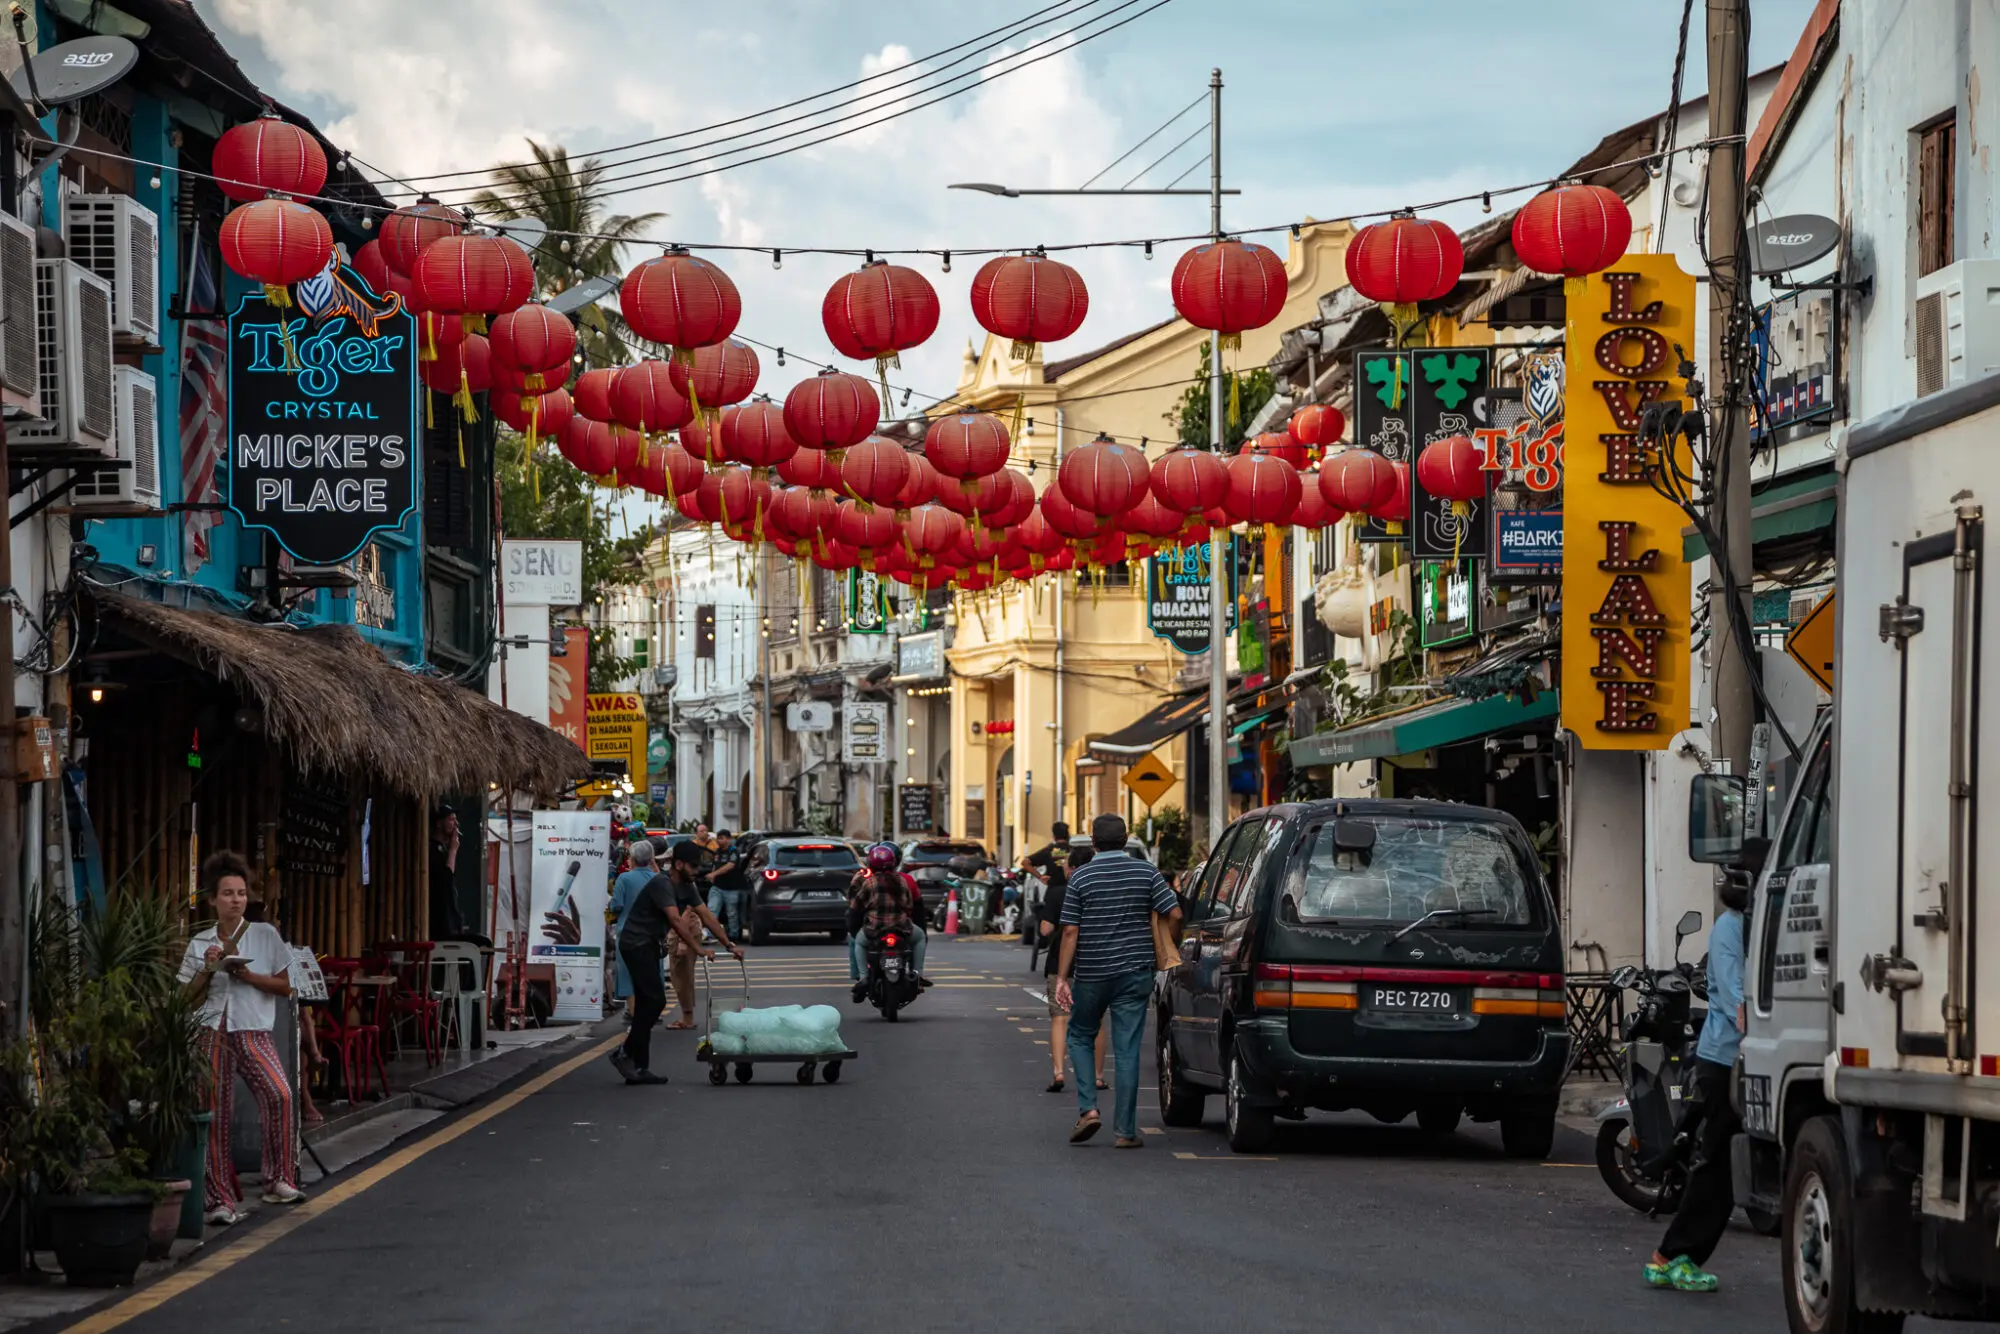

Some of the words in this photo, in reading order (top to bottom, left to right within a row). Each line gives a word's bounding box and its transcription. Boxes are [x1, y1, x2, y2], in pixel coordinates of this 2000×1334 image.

[62, 52, 114, 67] astro
[1766, 232, 1813, 245] astro
[239, 317, 404, 397] Tiger
[1593, 272, 1668, 484] LOVE
[265, 401, 379, 419] CRYSTAL
[238, 434, 406, 469] MICKE'S
[1473, 422, 1565, 492] Tig
[256, 478, 388, 512] PLACE
[1176, 586, 1210, 601] HOLY
[1152, 601, 1234, 618] GUACAME
[1152, 620, 1184, 628] MEXICAN
[1588, 521, 1666, 733] LANE
[1176, 629, 1192, 637] AND
[1193, 629, 1209, 637] BAR
[586, 696, 638, 711] AWAS
[612, 712, 645, 723] SEKOLAH
[550, 722, 577, 738] nk
[589, 726, 597, 735] DI
[599, 725, 632, 734] HADAPAN
[595, 742, 628, 751] SEKOLAH
[285, 832, 337, 853] WINE
[538, 848, 557, 856] Tune
[558, 848, 564, 856] It
[565, 848, 585, 856] Your
[586, 848, 604, 858] Way
[551, 946, 557, 955] 3
[1375, 990, 1406, 1006] PEC
[1410, 991, 1451, 1008] 7270
